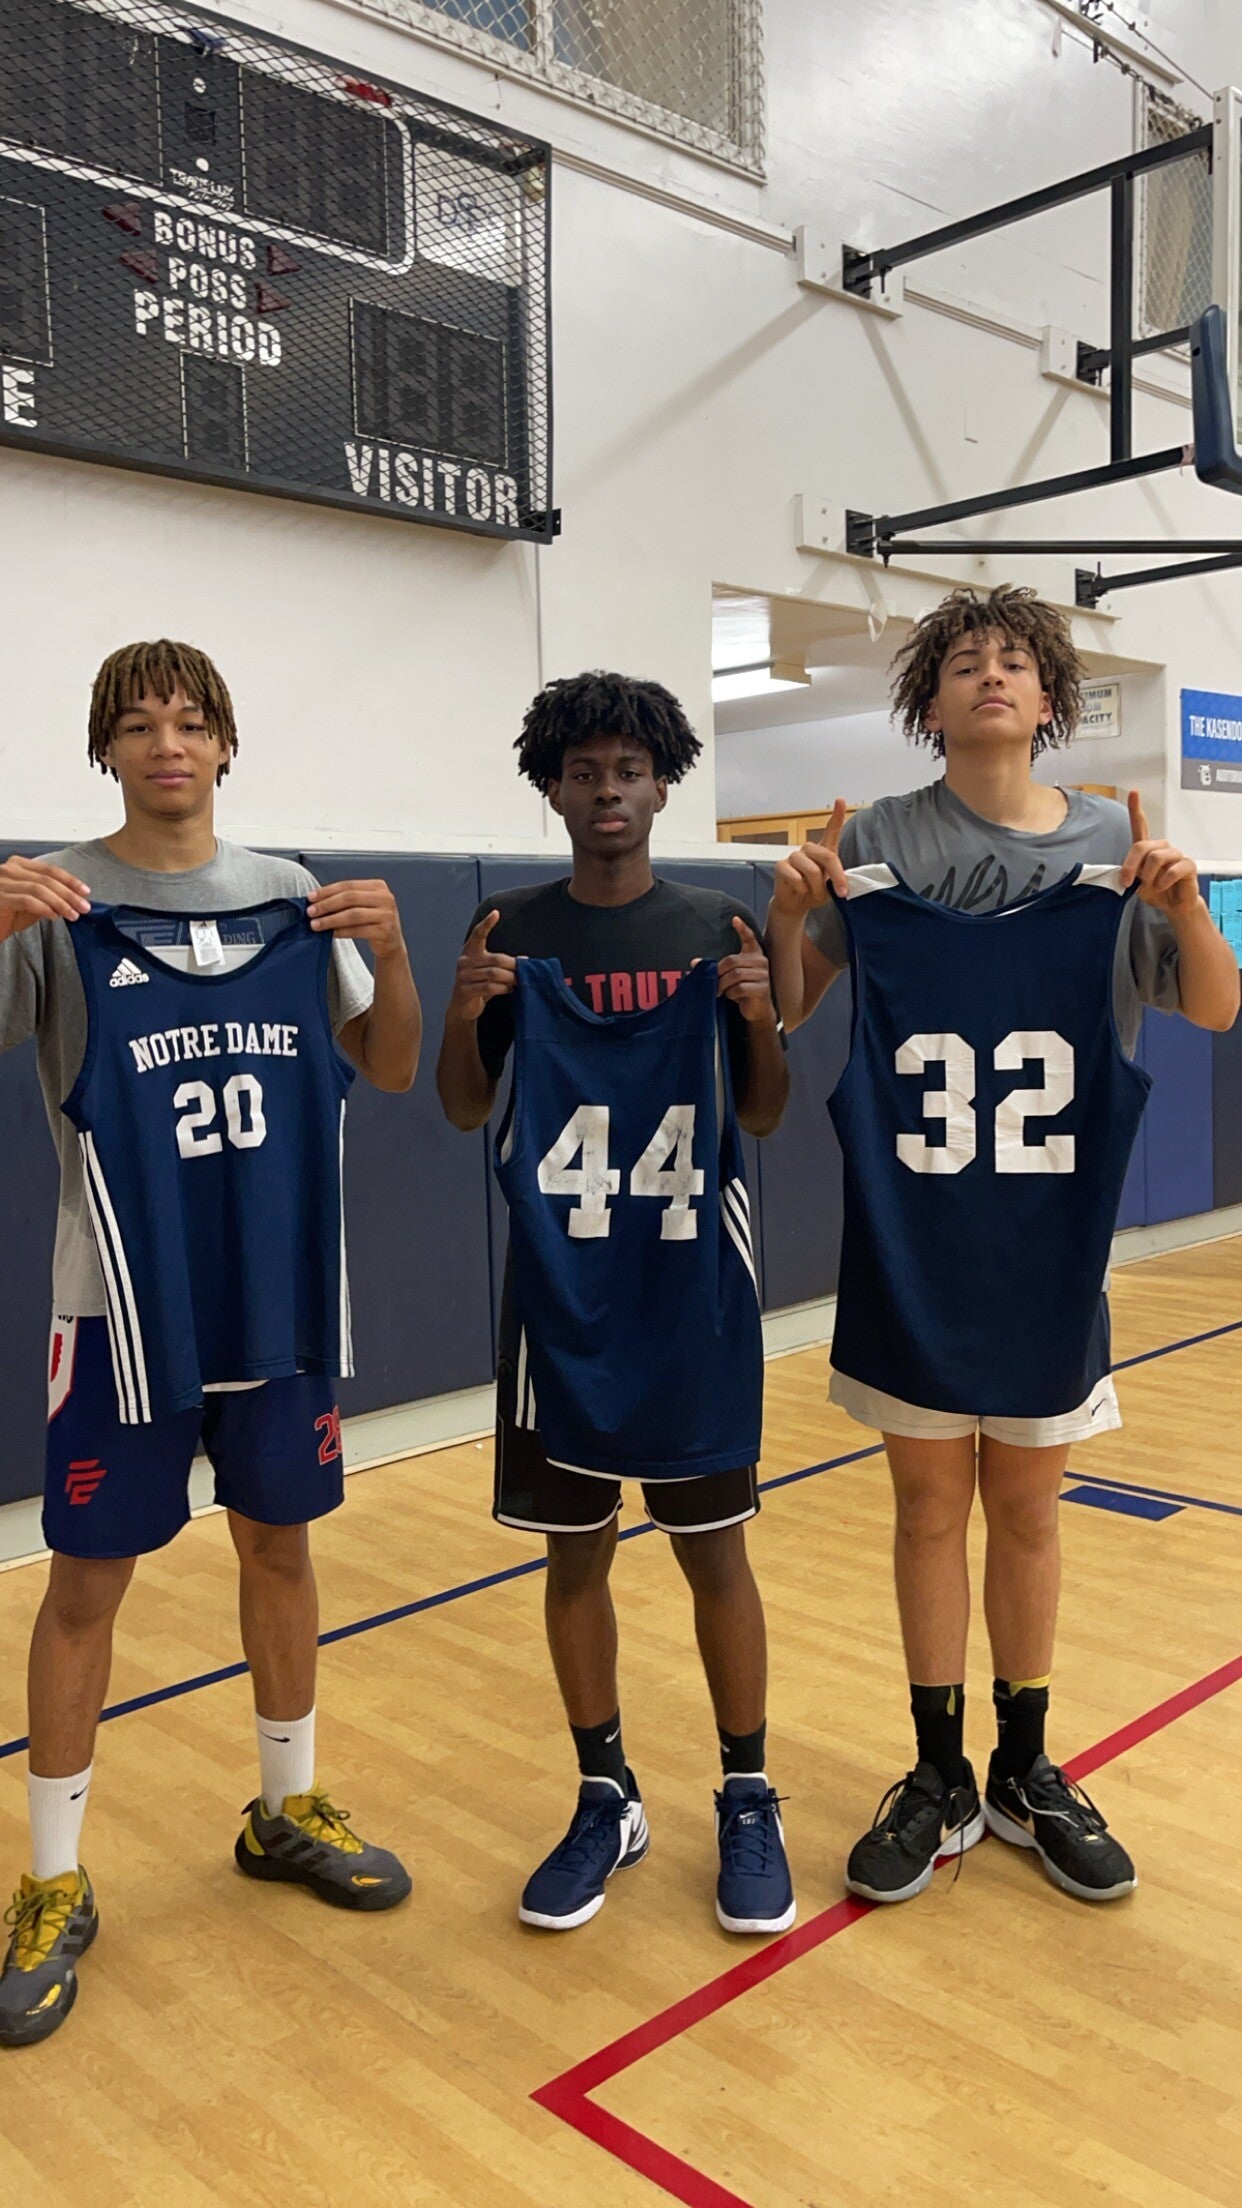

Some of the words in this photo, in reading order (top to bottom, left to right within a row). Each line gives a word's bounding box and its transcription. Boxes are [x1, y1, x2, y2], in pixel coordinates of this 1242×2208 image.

[153, 211, 257, 270] BONUS
[168, 256, 247, 310] POSS
[134, 289, 282, 367] PERIOD
[344, 441, 520, 528] VISITOR
[1082, 712, 1113, 725] ACITY
[1189, 714, 1206, 738] THE
[109, 972, 150, 988] adidas
[585, 970, 691, 1013] TRUT
[128, 1023, 221, 1074] NOTRE
[225, 1021, 299, 1058] DAME
[173, 1073, 267, 1160] 20
[894, 1030, 1075, 1174] 32
[537, 1104, 705, 1241] 44
